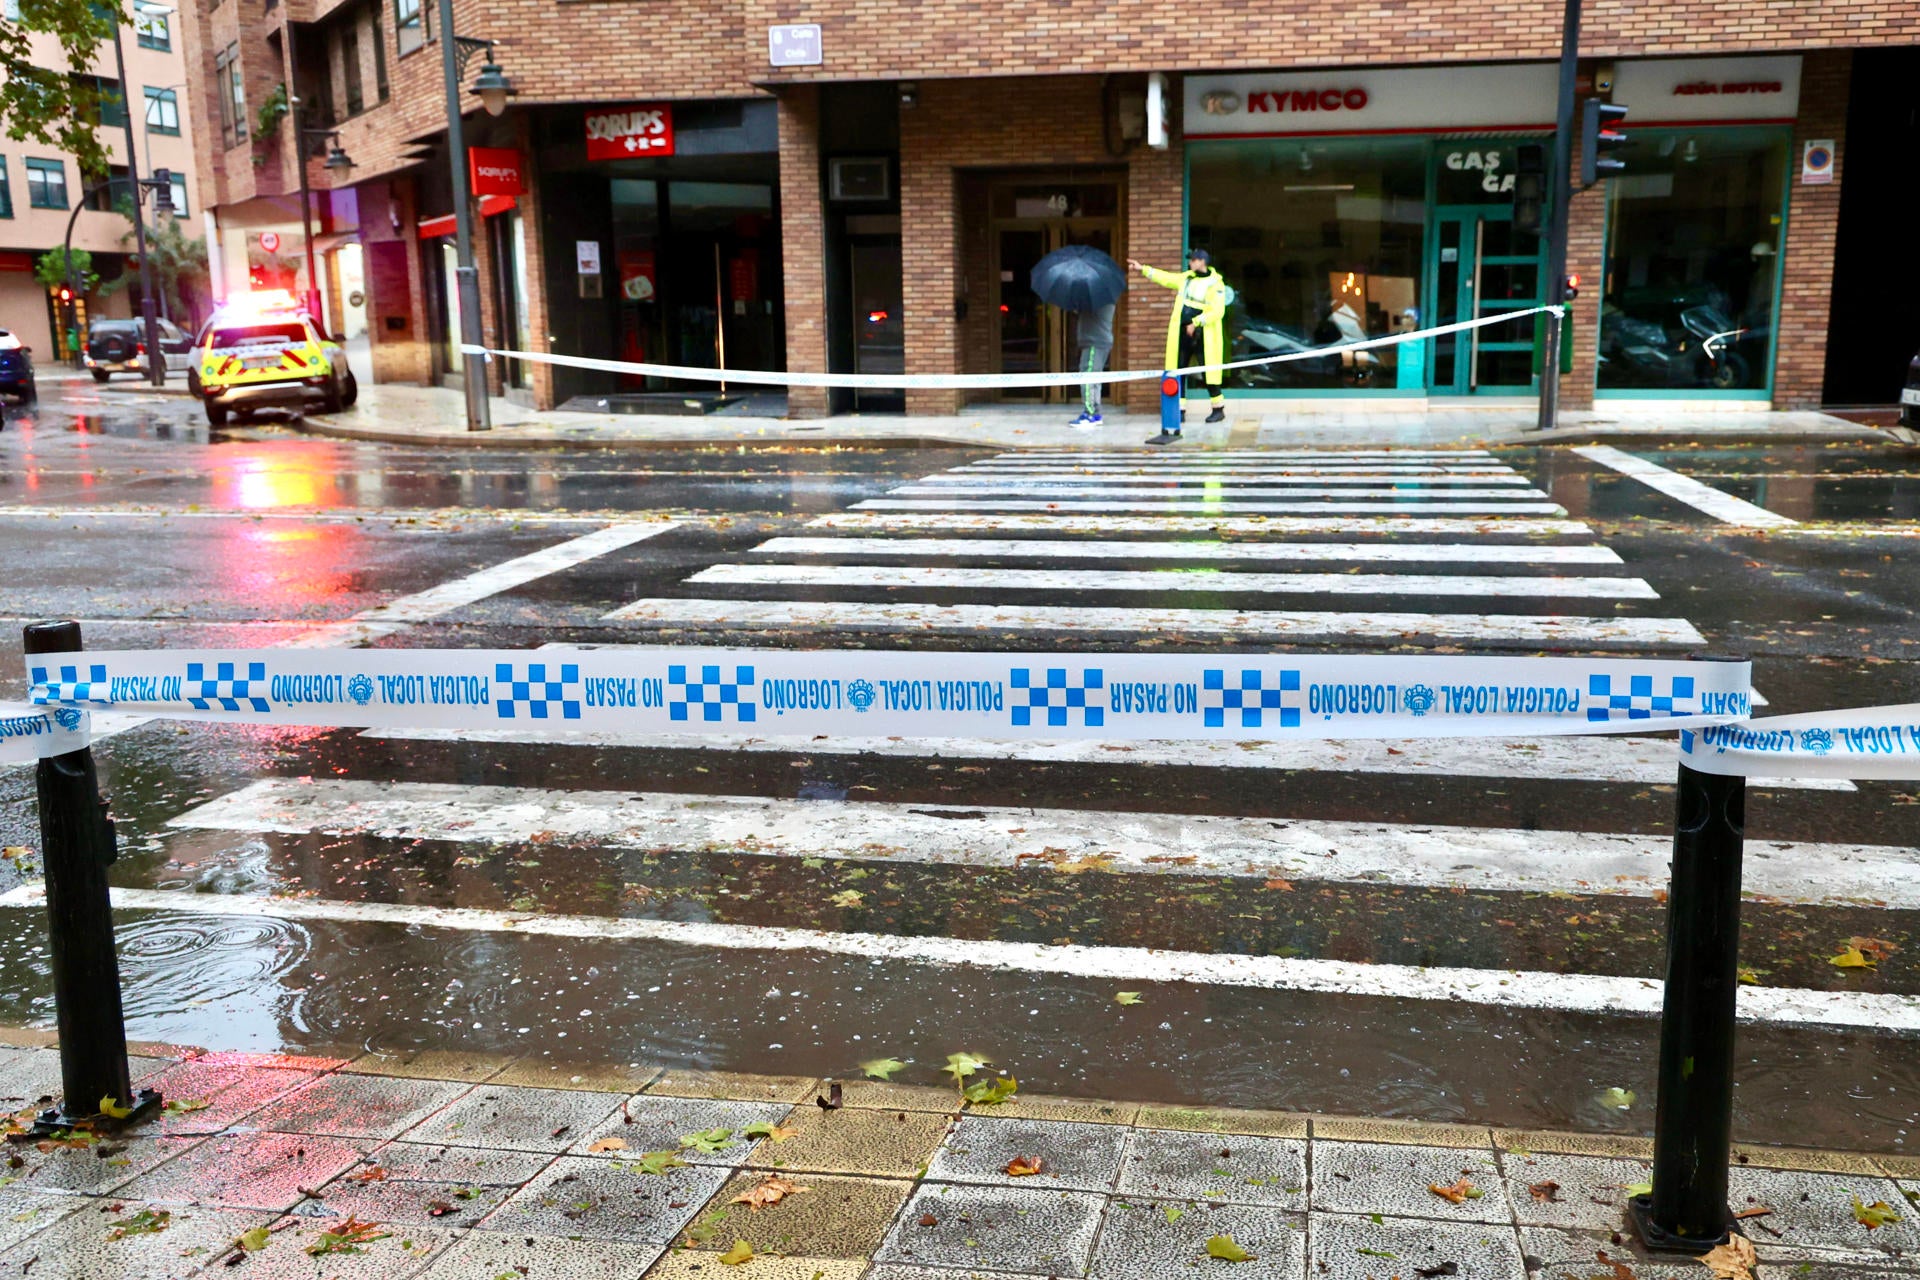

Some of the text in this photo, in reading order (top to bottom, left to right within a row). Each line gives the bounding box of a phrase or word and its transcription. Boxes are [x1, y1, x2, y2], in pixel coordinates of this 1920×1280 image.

[1247, 88, 1368, 113] KYMCO
[586, 110, 665, 142] SQRUPS
[1446, 151, 1500, 170] GAS
[1482, 173, 1517, 192] GA
[1048, 194, 1067, 210] 48
[109, 675, 182, 704] NO PASAR
[271, 674, 489, 707] POLICIA LOCAL LOGROÑO
[585, 677, 664, 708] NO PASAR
[762, 678, 1003, 715] POLICIA LOCAL LOGROÑO
[1110, 682, 1198, 714] NO PASAR
[1309, 683, 1580, 721] POLICIA LOCAL LOGROÑO
[1838, 725, 1906, 754] LOCAL
